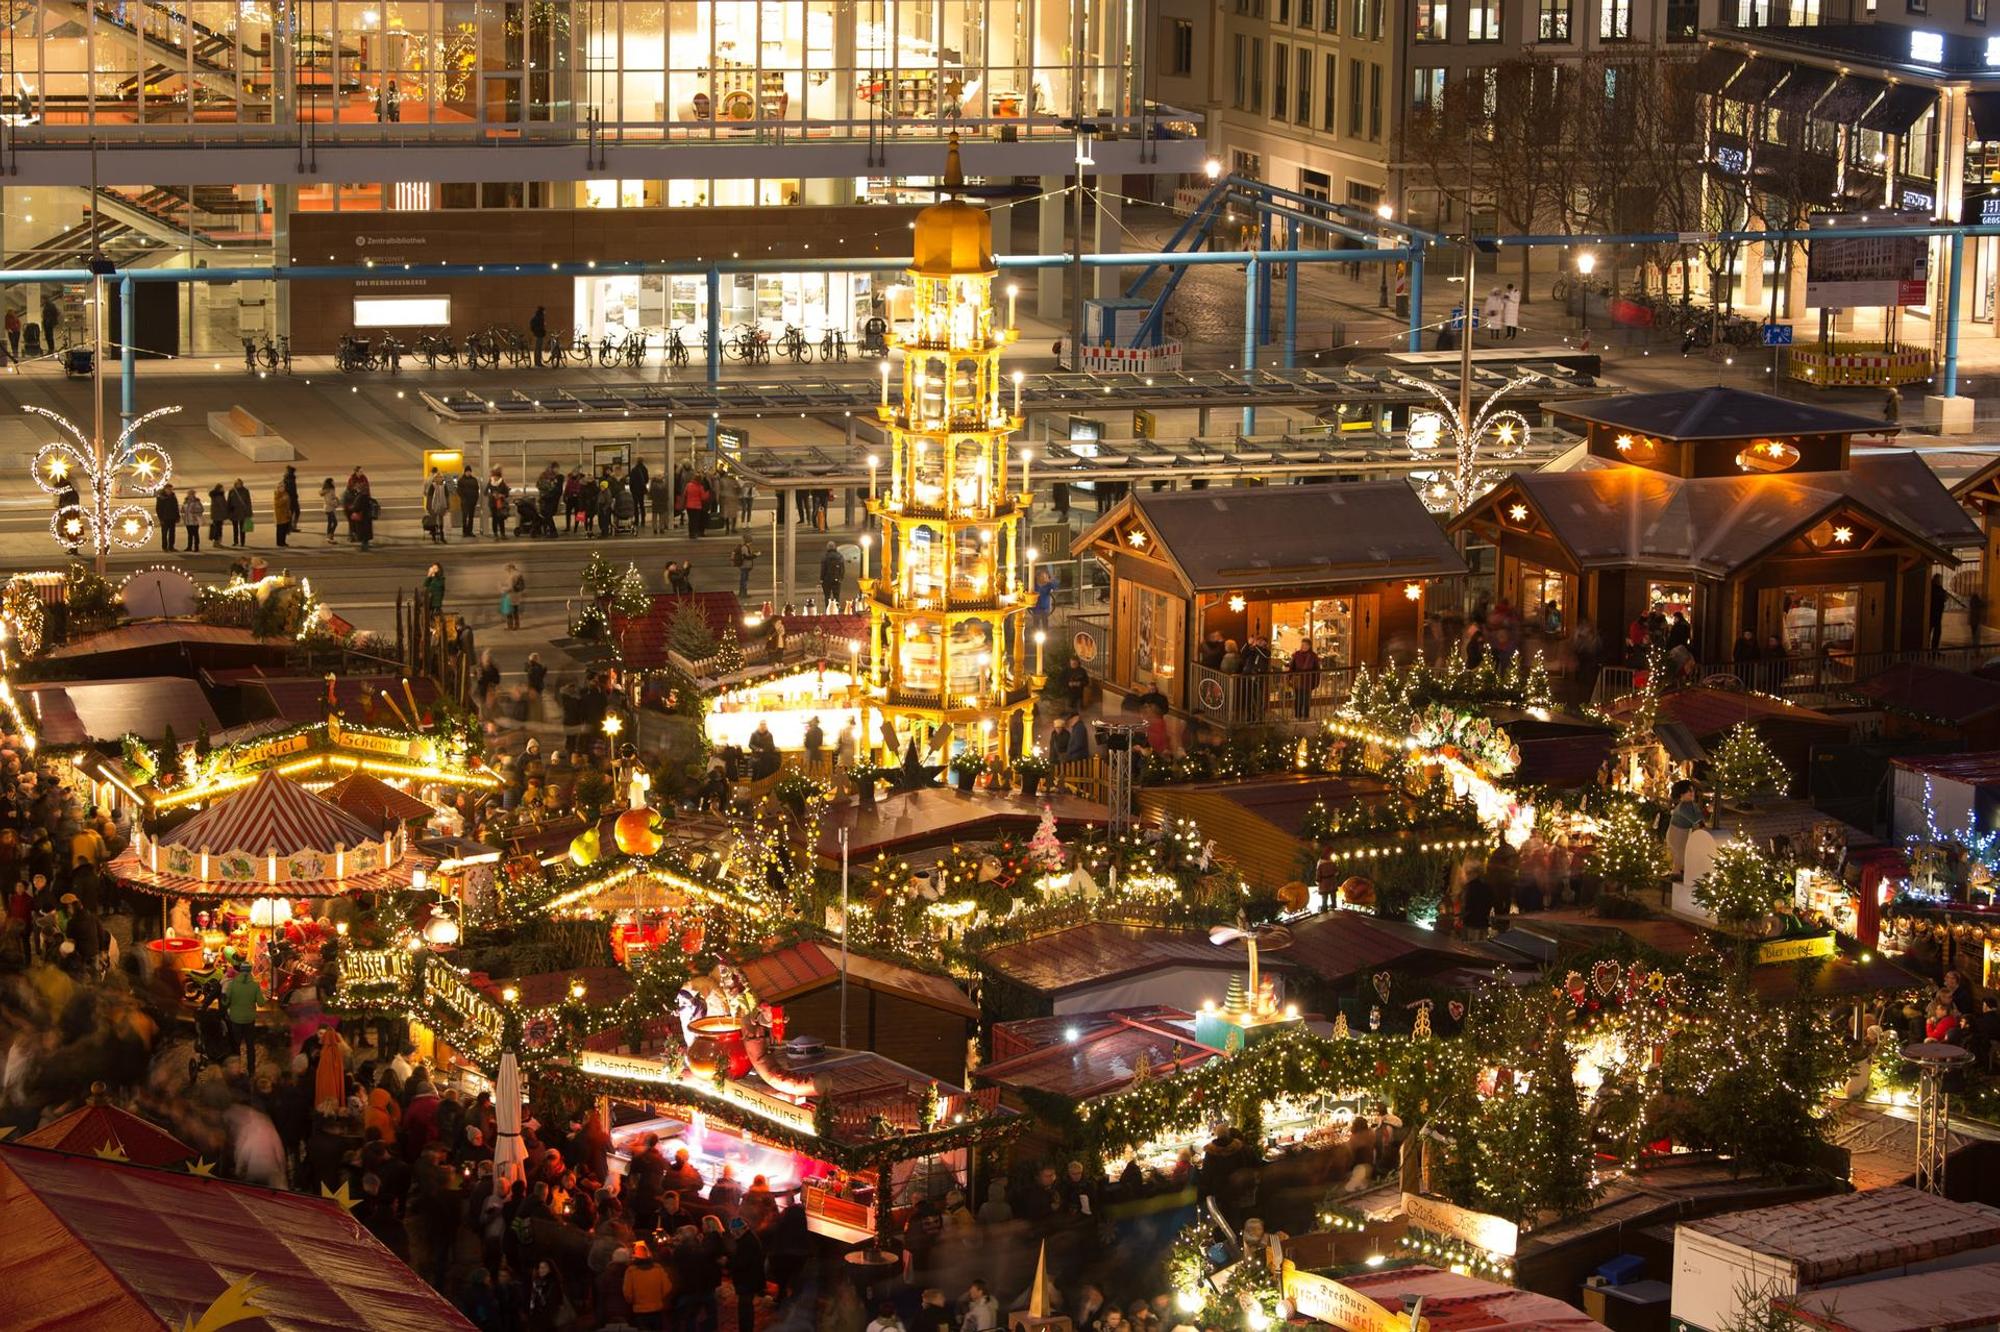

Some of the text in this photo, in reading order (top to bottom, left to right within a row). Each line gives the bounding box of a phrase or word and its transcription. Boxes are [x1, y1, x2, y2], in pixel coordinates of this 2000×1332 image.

[347, 955, 388, 978] HEISSER
[733, 1087, 804, 1127] Bratwurst
[1320, 1284, 1368, 1314] Dresdner
